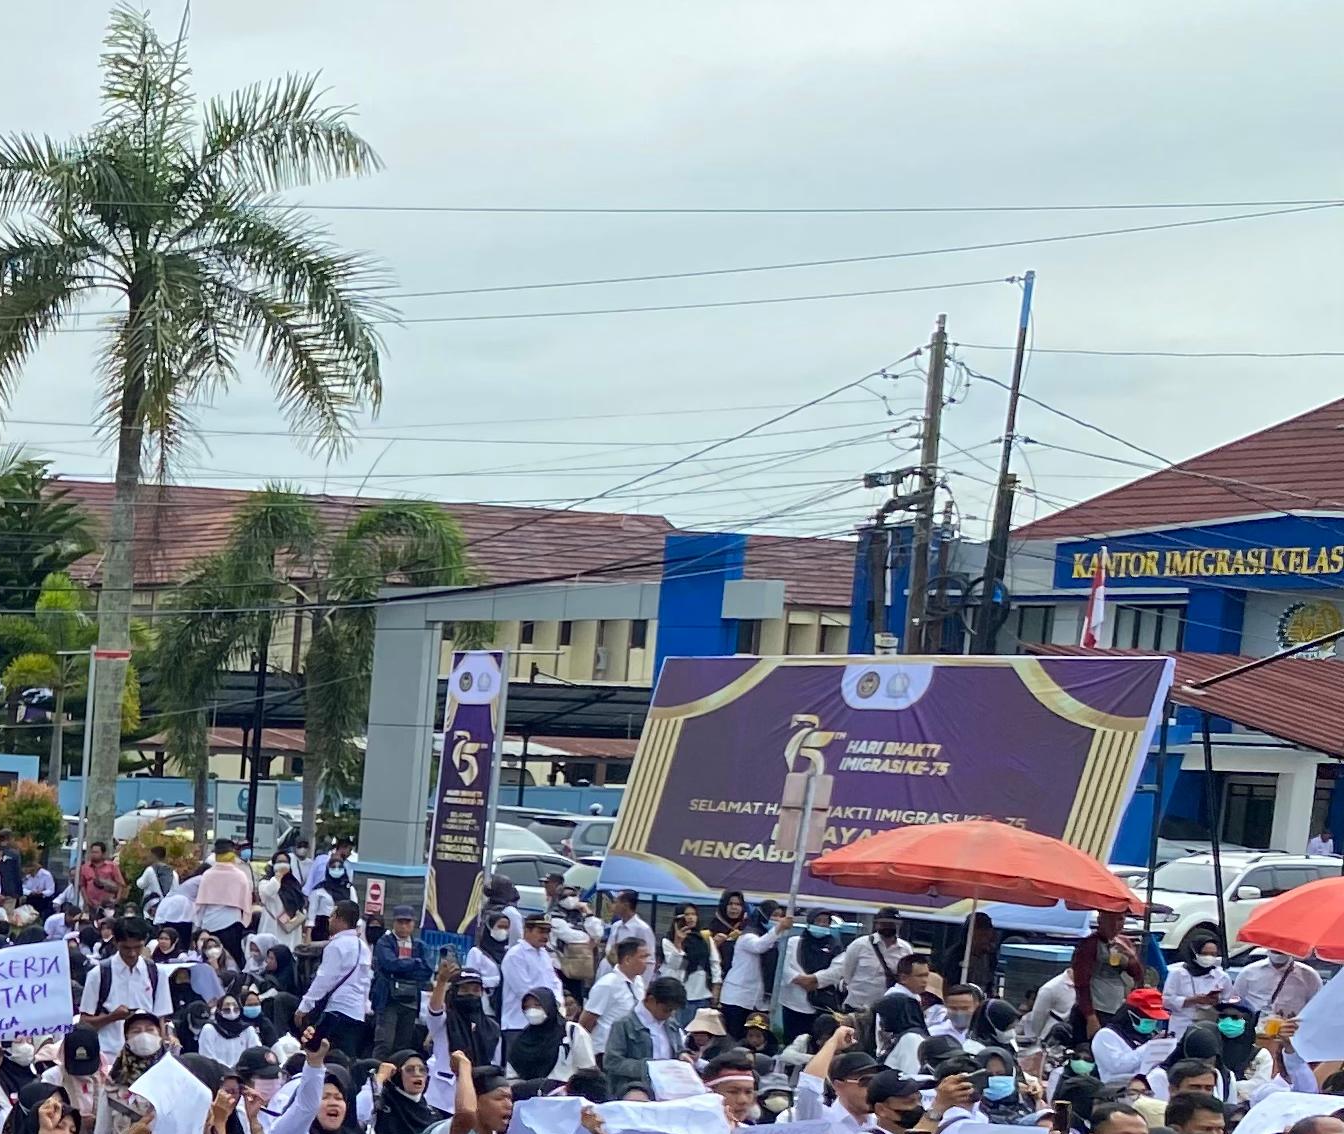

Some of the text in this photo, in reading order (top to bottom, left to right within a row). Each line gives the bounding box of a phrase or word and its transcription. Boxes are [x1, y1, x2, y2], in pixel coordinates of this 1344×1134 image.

[1072, 545, 1344, 579] KANTOR IMIGRASI KELAS
[846, 740, 942, 757] HARI BHAKTI
[839, 757, 951, 776] IMIGRASI KE-75
[689, 799, 763, 815] SELAMAT
[826, 805, 872, 822] AKTI
[680, 838, 797, 864] MENGABD
[0, 983, 48, 1009] TAPI
